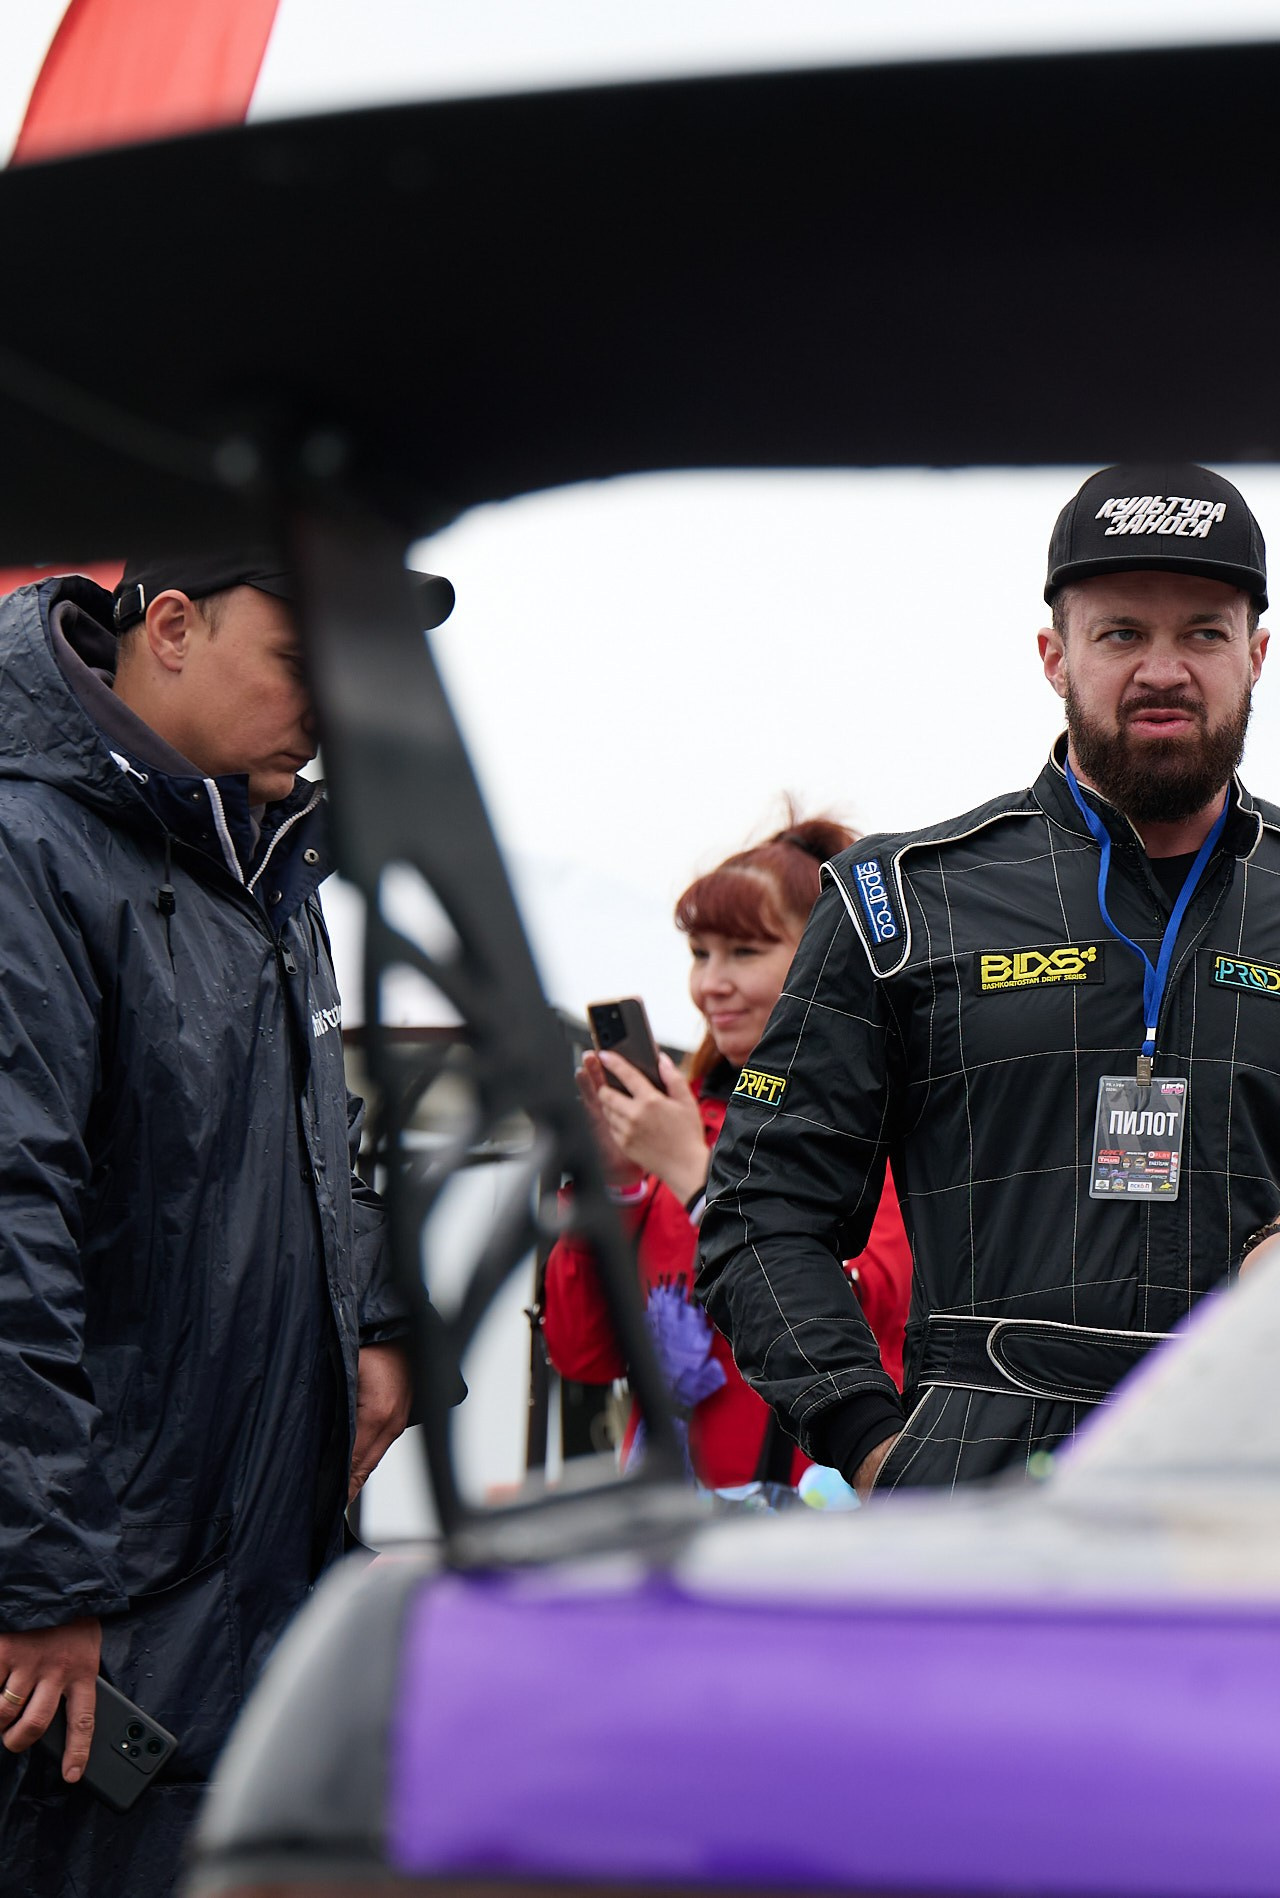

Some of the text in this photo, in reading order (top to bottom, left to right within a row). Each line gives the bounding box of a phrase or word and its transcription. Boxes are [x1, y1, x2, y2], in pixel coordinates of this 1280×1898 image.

[1095, 496, 1227, 523] КУЛЬТУРА
[1104, 514, 1213, 538] ЗАНОСА
[982, 972, 1087, 990] BASHKORTOSTAN DRIFT SERIES
[1109, 1110, 1178, 1136] ПИЛОТ
